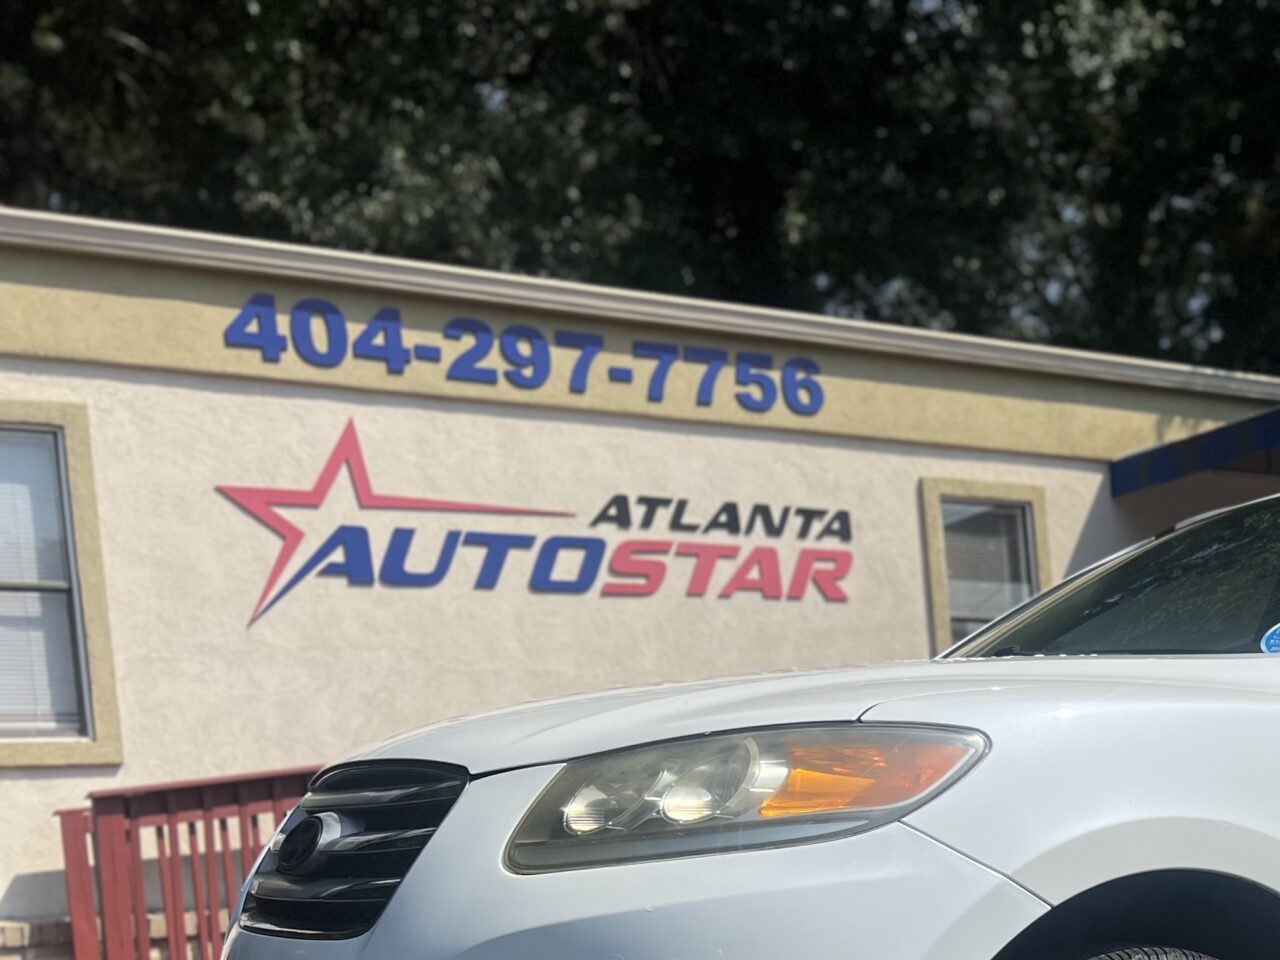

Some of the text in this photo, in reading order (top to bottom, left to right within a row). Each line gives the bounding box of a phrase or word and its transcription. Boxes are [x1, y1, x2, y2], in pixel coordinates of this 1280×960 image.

[223, 292, 825, 416] 404-297-7756
[589, 493, 854, 544] ATLANTA
[312, 523, 854, 603] AUTOSTAR
